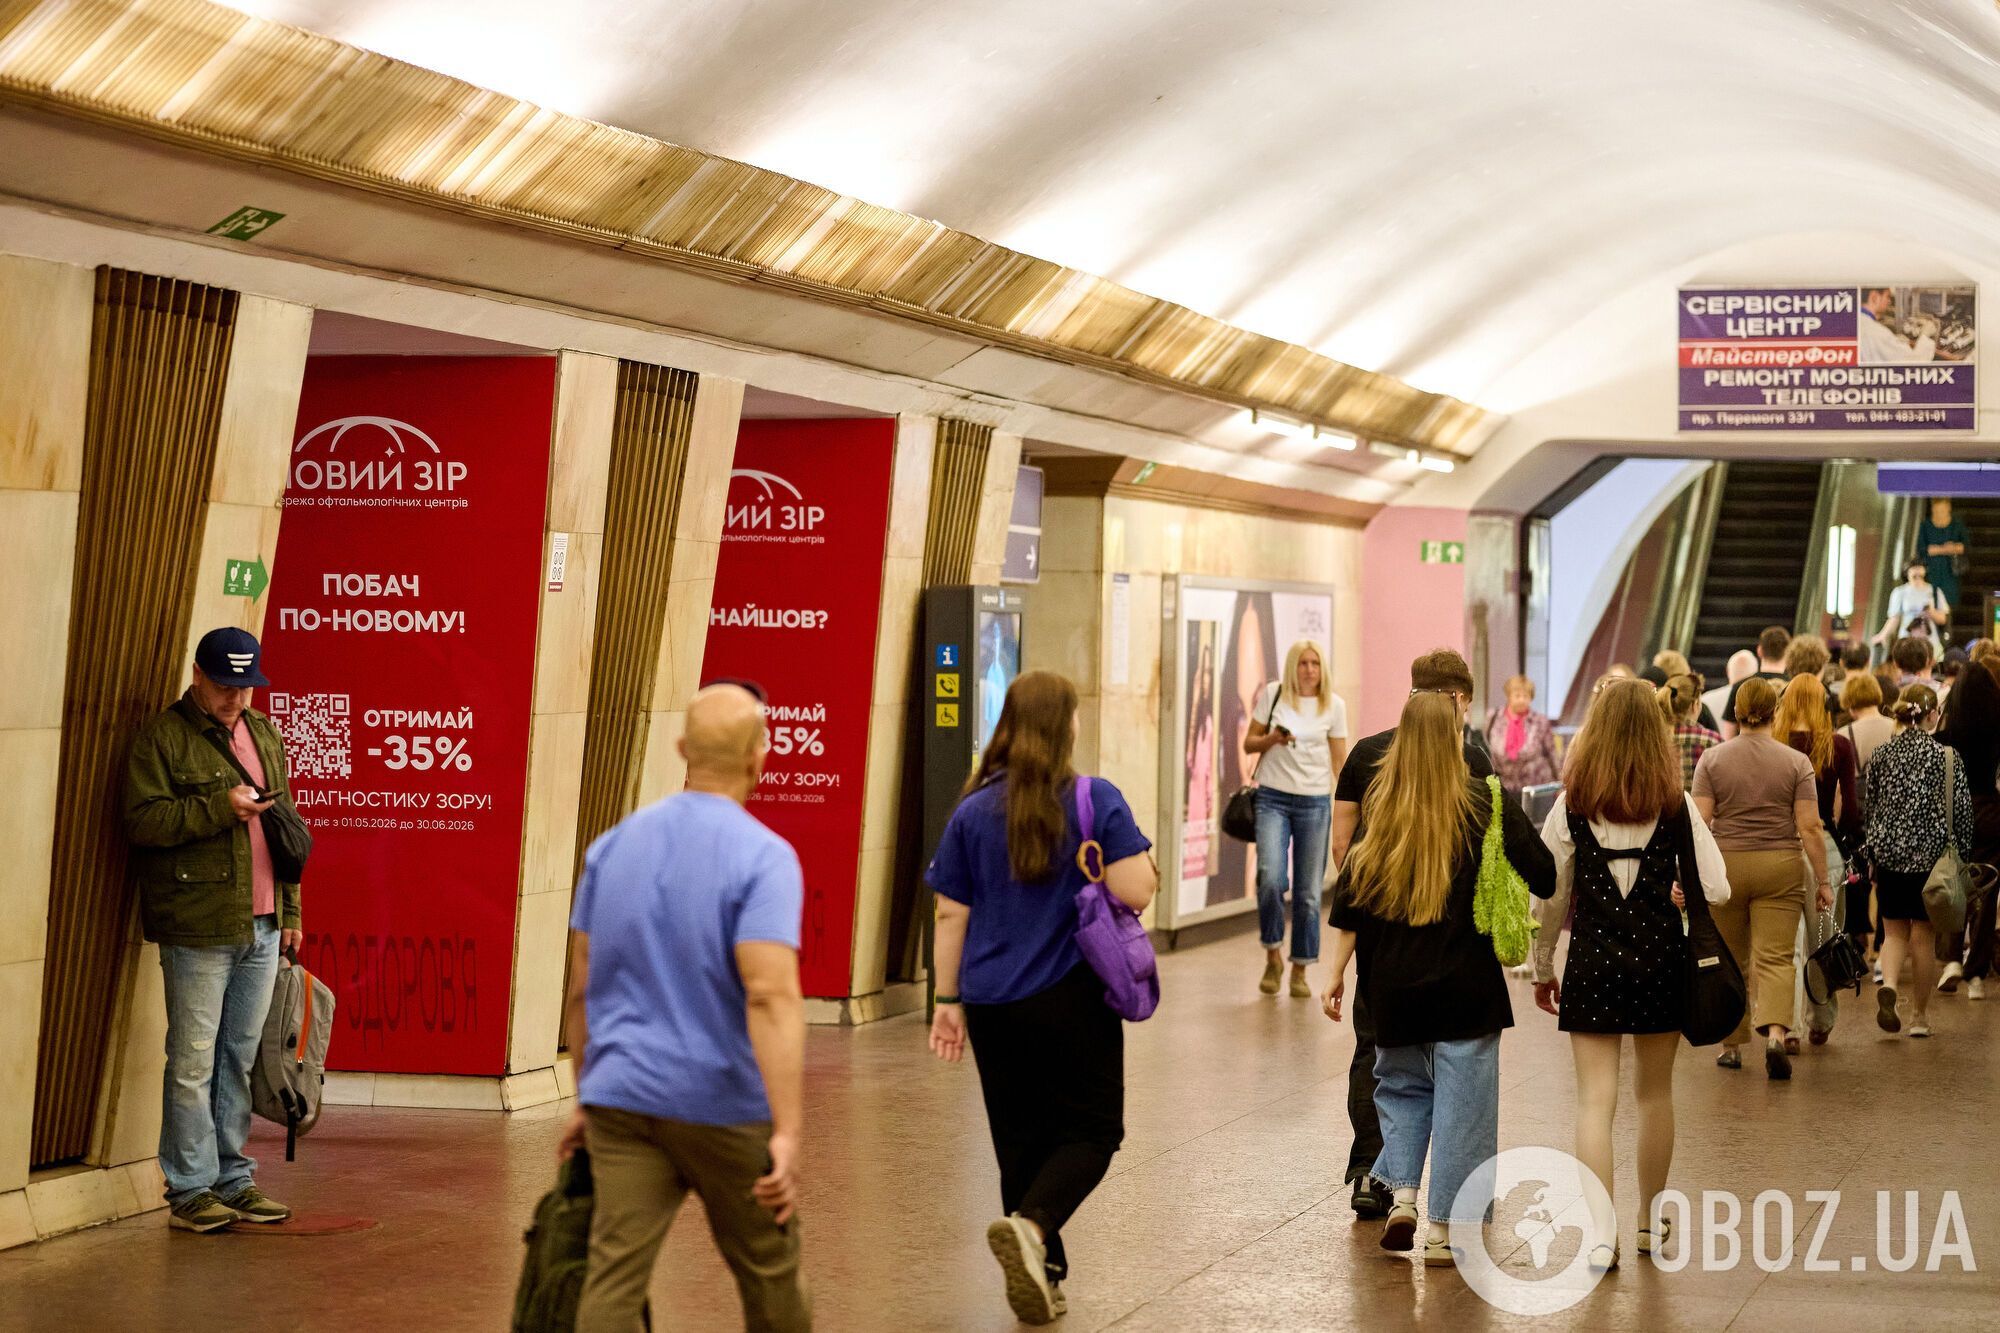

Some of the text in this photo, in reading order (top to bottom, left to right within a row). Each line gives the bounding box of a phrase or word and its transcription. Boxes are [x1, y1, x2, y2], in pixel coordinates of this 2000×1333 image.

[1686, 291, 1853, 315] СЕРВІСНИЙ
[1726, 316, 1822, 339] ЦЕНТР
[1691, 346, 1853, 367] МайстерФон
[1703, 367, 1955, 387] РЕМОНТ МОБІЛЬНИХ
[1761, 388, 1902, 405] ТЕЛЕФОНІВ
[1716, 411, 1785, 427] Перемоги
[287, 447, 468, 491] ОВИЙ ЗІР
[280, 495, 469, 510] ережа офтальмологічних центрів
[780, 505, 825, 530] ЗІР
[323, 573, 419, 597] ПОБАЧ
[280, 608, 466, 633] ПО-НОВОМУ!
[363, 706, 474, 729] ОТРИМАЙ
[367, 735, 473, 772] -35%
[794, 772, 840, 787] ЗОРУ!
[295, 789, 492, 810] ДІАГНОСТИКУ ЗОРУ!
[314, 816, 330, 828] діє
[341, 817, 397, 828] 01.05.2026
[399, 820, 414, 830] до
[416, 819, 475, 831] 30.06.2026
